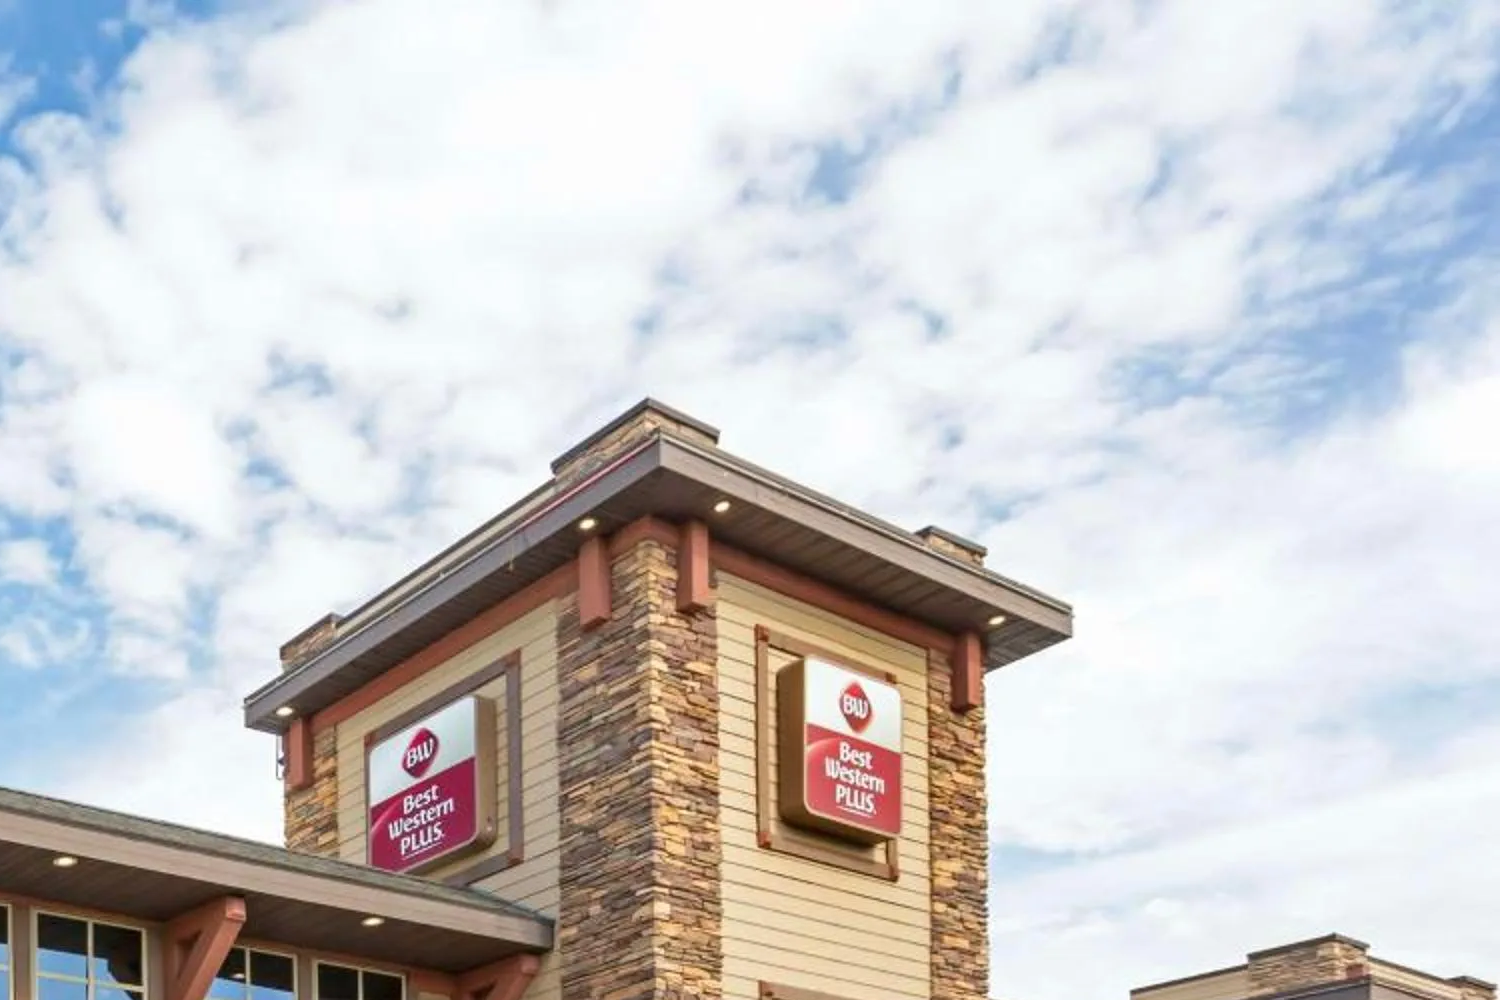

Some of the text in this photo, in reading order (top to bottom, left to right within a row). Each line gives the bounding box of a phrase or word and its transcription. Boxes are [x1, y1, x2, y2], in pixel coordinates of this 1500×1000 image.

[843, 695, 868, 718] BW
[407, 740, 433, 767] BW
[839, 741, 873, 769] Best
[825, 757, 885, 793] Western
[403, 785, 439, 813] Best
[835, 784, 875, 813] PLUS
[387, 798, 455, 840] Western
[400, 821, 441, 855] PLUS
